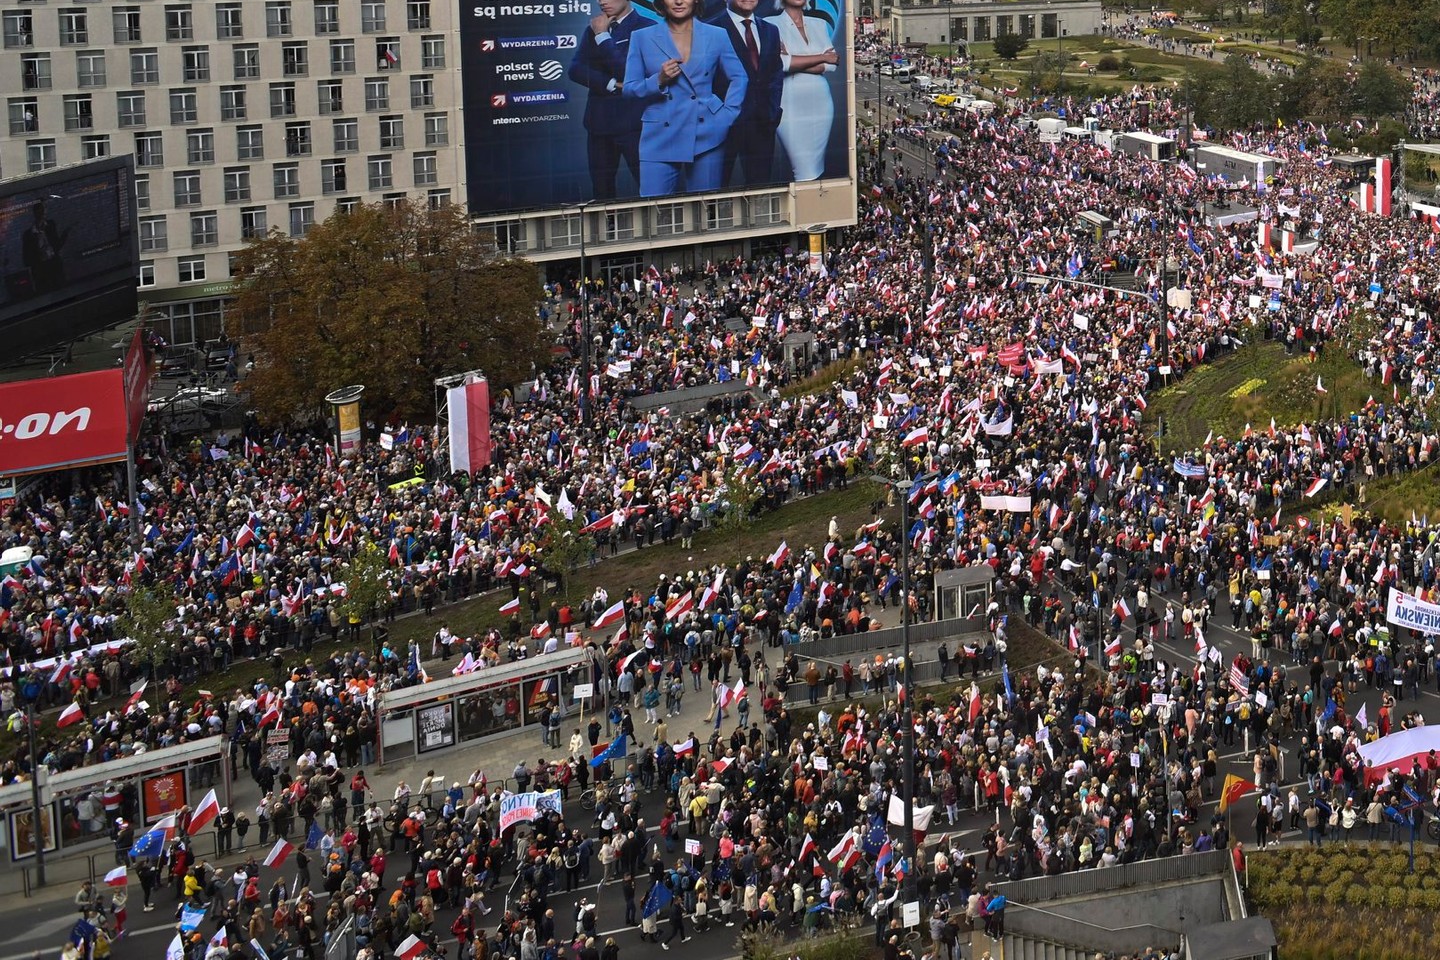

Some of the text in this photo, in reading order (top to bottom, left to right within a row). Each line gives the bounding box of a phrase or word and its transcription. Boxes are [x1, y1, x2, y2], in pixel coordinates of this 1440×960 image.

[474, 0, 592, 19] są naszą siłą
[500, 36, 575, 49] WYDARZENIA 24
[496, 61, 534, 74] polsat
[504, 71, 535, 81] news
[512, 92, 565, 103] WYDARZENIA
[521, 113, 570, 123] WYDARZENIA
